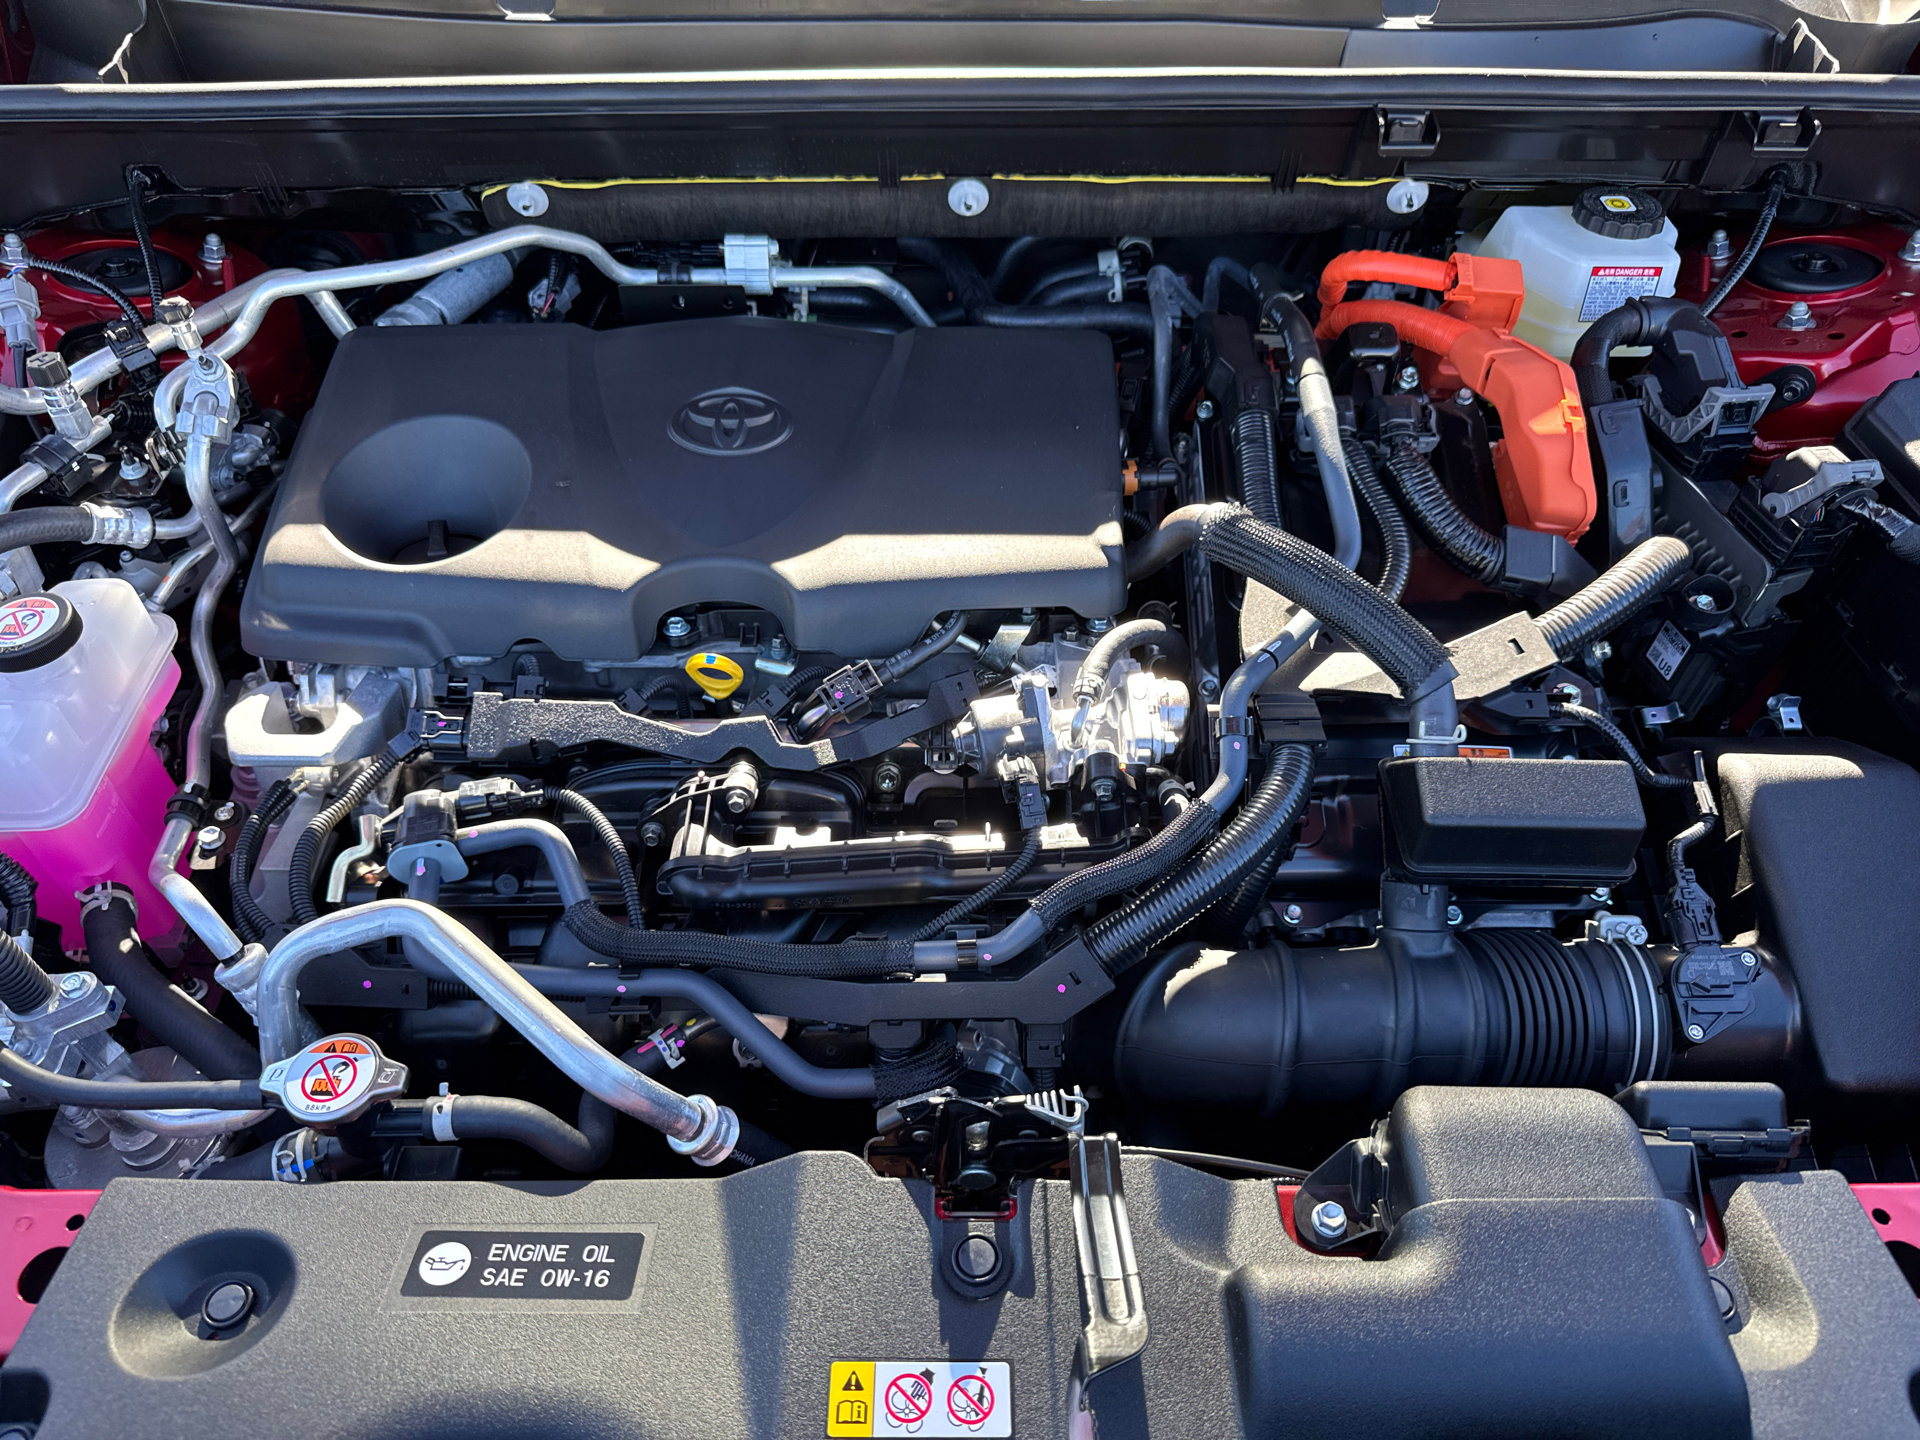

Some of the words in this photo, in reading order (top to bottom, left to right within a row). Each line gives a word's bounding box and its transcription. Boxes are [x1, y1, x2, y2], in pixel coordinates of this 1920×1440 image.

[1615, 268, 1643, 276] DANGER
[1658, 658, 1672, 677] U8
[487, 1243, 570, 1262] ENGINE
[582, 1244, 615, 1263] OIL
[479, 1268, 528, 1287] SAE
[540, 1269, 611, 1288] 0W-16
